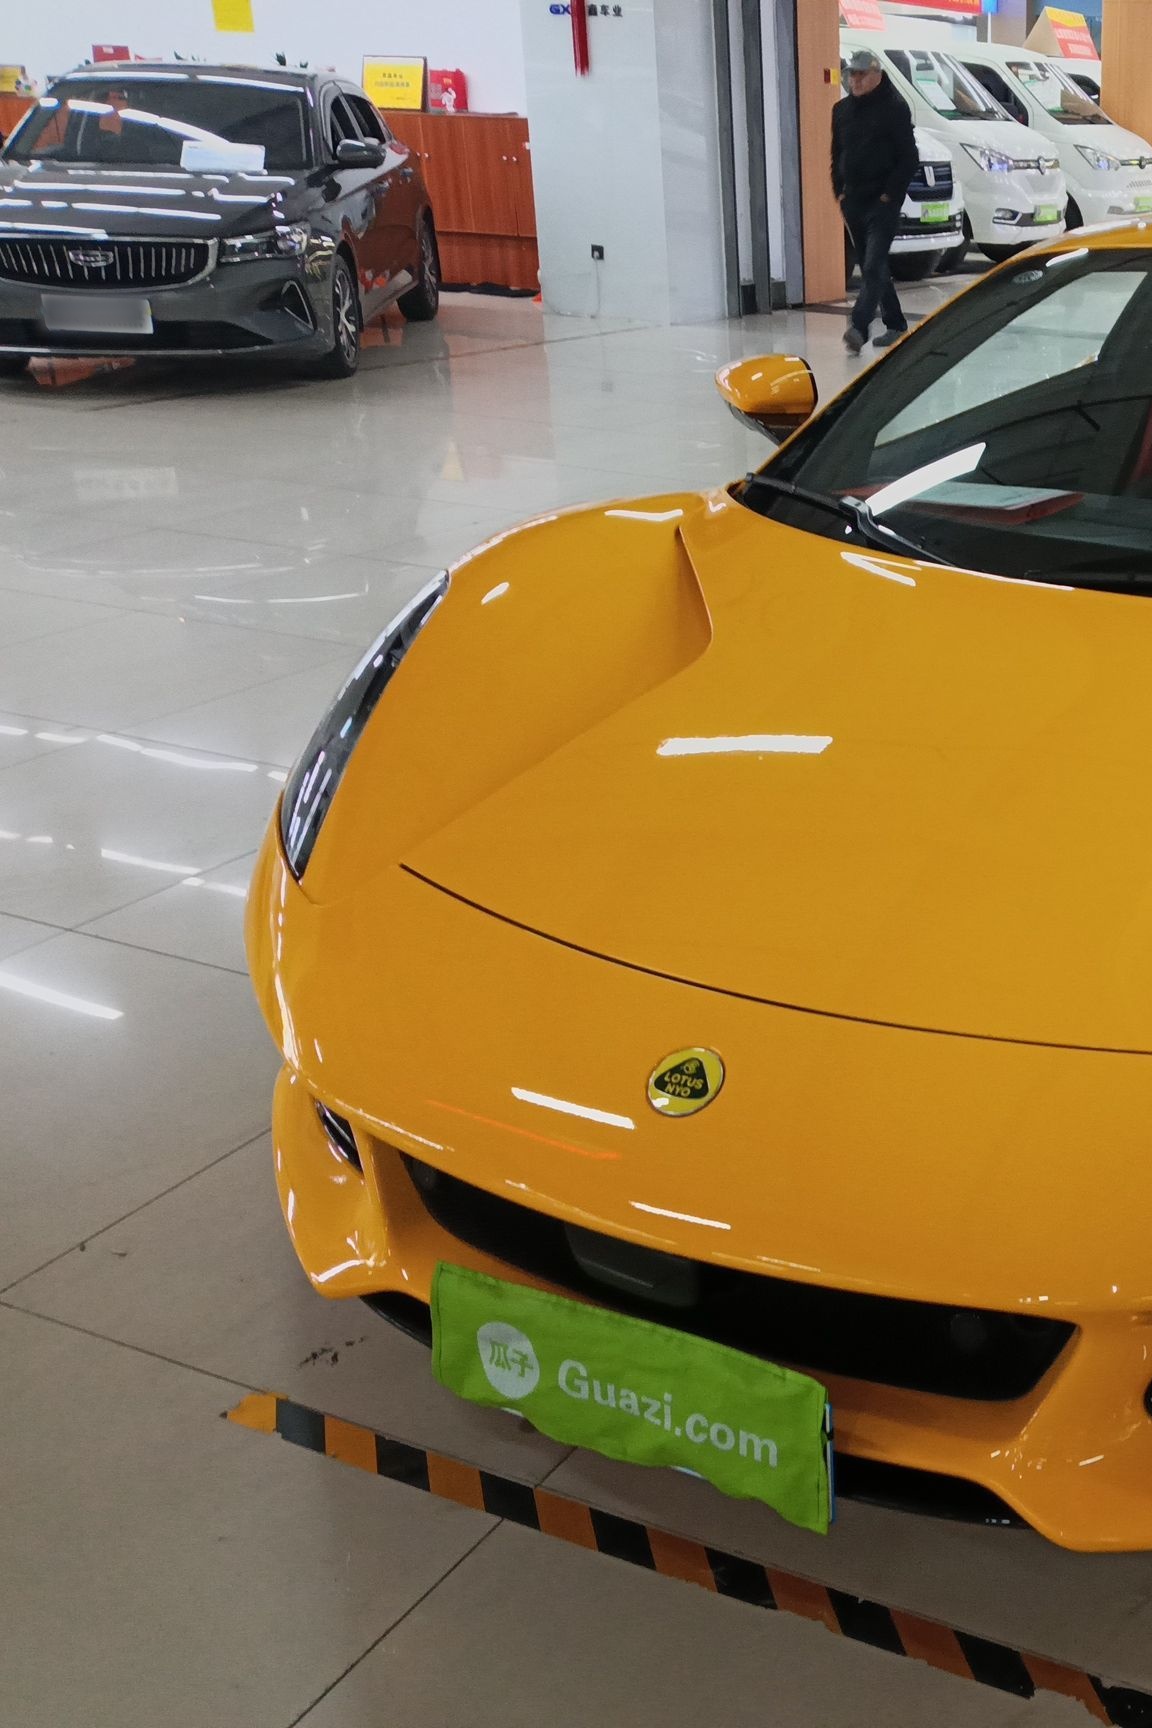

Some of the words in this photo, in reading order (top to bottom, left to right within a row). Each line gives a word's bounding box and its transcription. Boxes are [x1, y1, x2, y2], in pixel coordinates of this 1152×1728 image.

[664, 1072, 704, 1090] LOTUS
[489, 1341, 534, 1378] 瓜子
[558, 1359, 778, 1468] Guazi.com
